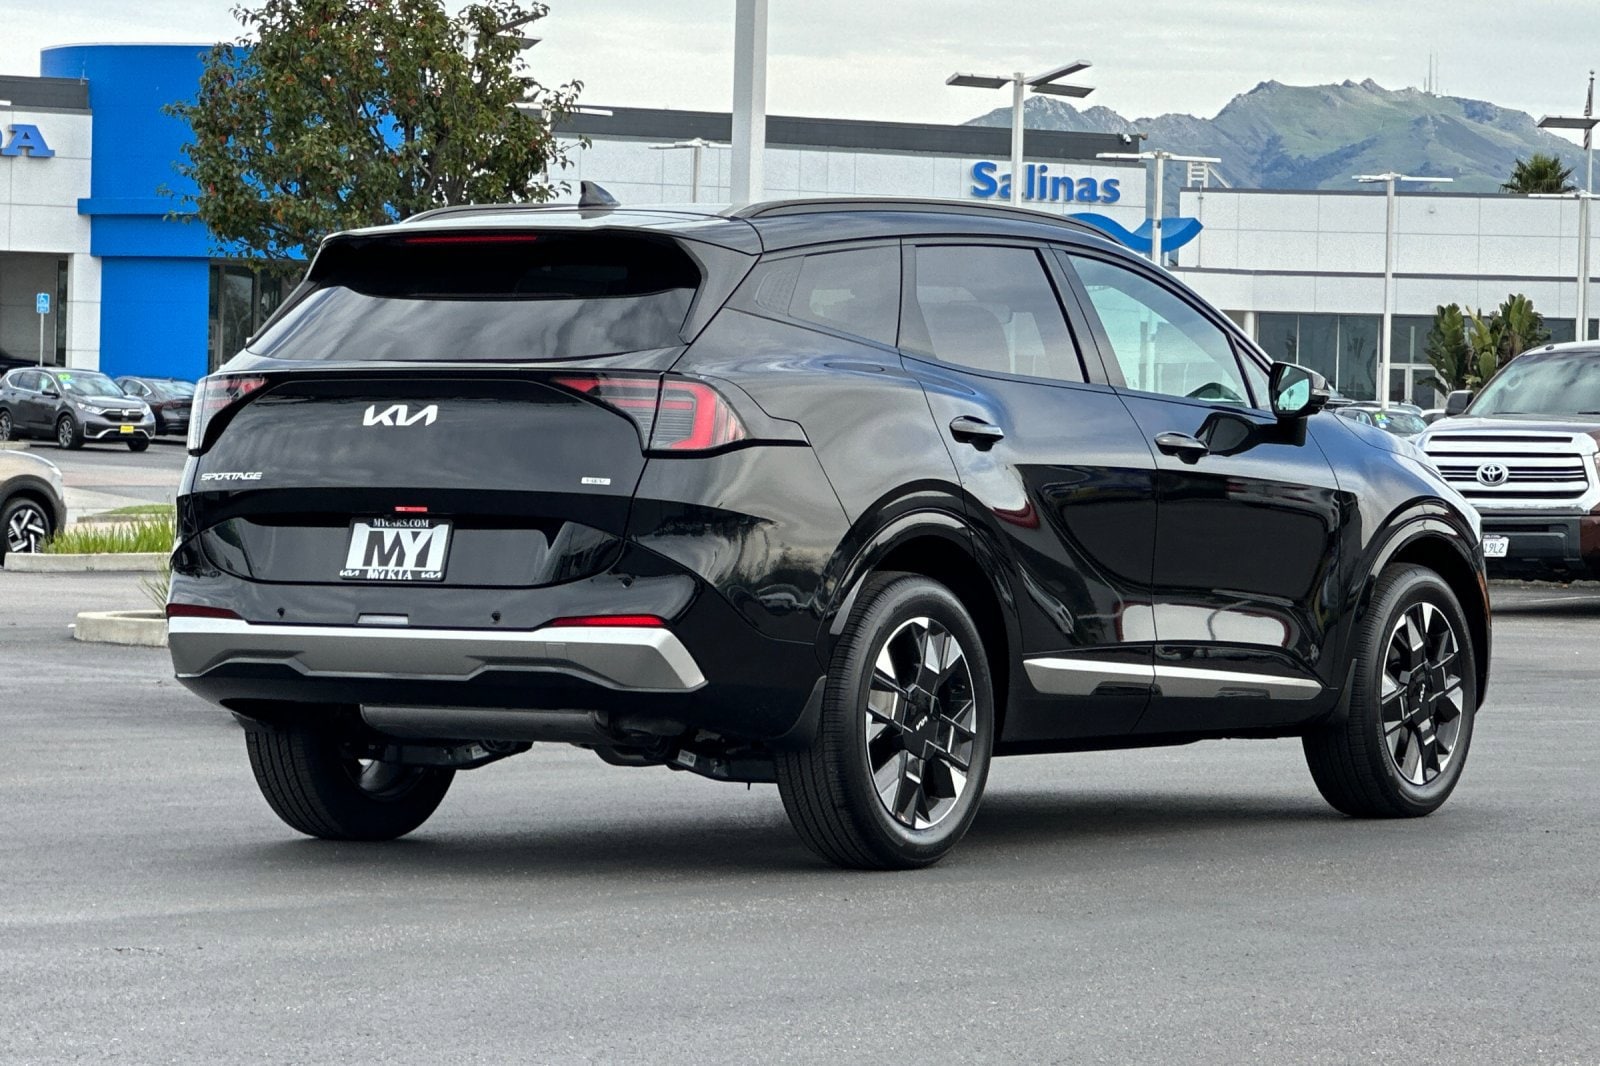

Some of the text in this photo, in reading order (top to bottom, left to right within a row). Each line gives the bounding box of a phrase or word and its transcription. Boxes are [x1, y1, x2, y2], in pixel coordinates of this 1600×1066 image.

[0, 124, 55, 158] A
[971, 161, 1121, 203] Salinas
[363, 404, 438, 426] KIA
[200, 471, 263, 481] SPORTAGE
